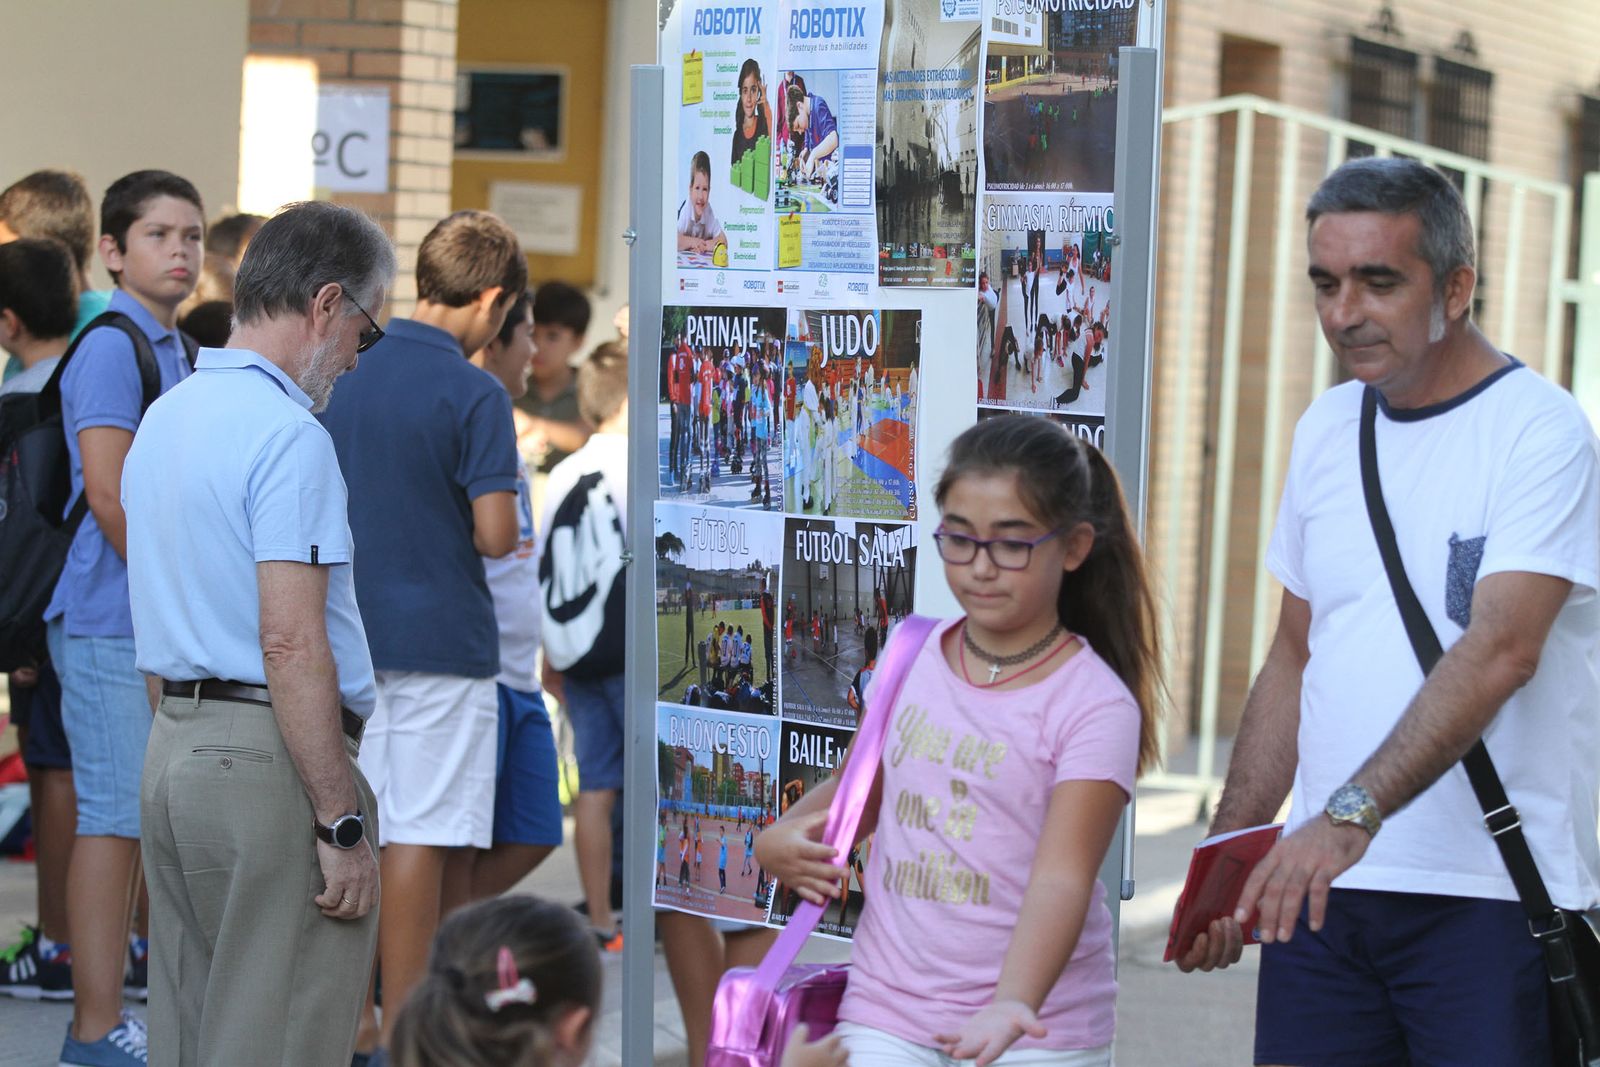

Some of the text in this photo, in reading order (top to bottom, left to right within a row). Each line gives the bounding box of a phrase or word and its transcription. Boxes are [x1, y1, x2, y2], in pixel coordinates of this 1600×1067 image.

[693, 7, 762, 36] ROBOTIX
[789, 7, 866, 39] ROBOTIX
[788, 41, 868, 53] Construye tus habilidades
[986, 196, 1115, 233] GIMNASIA RÍTMIC
[743, 280, 766, 290] ROBOTIX
[848, 282, 869, 293] ROBOTIX
[687, 314, 759, 358] PATINAJE
[820, 314, 878, 369] JUDO
[907, 480, 916, 519] CURSO
[691, 508, 749, 555] FÚTBOL
[796, 520, 906, 568] FÚTBOL SALA
[669, 714, 772, 760] BALONCESTO
[789, 731, 834, 769] BAILE
[952, 734, 1009, 780] are
[896, 789, 941, 833] one
[894, 848, 991, 906] million
